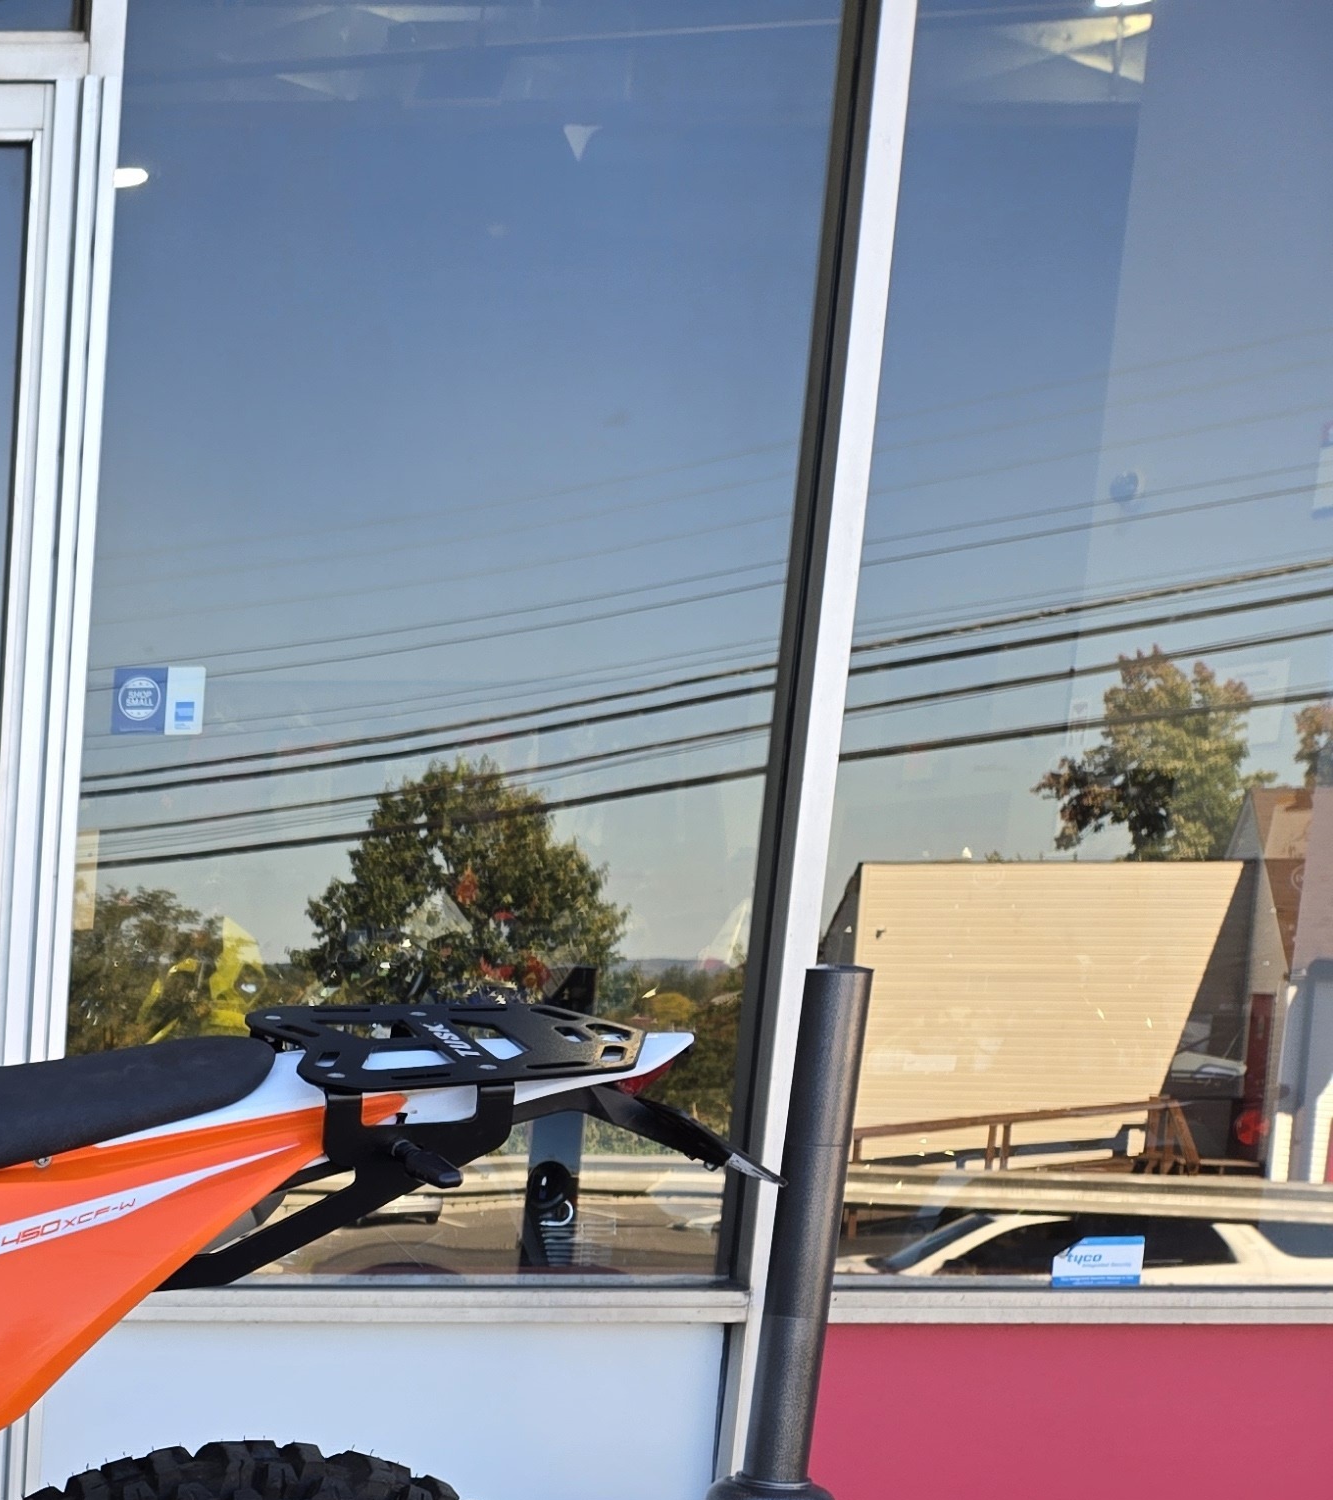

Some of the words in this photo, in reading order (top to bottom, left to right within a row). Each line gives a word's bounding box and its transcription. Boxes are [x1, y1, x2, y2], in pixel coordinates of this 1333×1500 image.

[128, 690, 153, 698] SHOP
[125, 698, 154, 707] SMALL
[419, 1021, 483, 1057] TUSK
[1066, 1253, 1102, 1265] tyco
